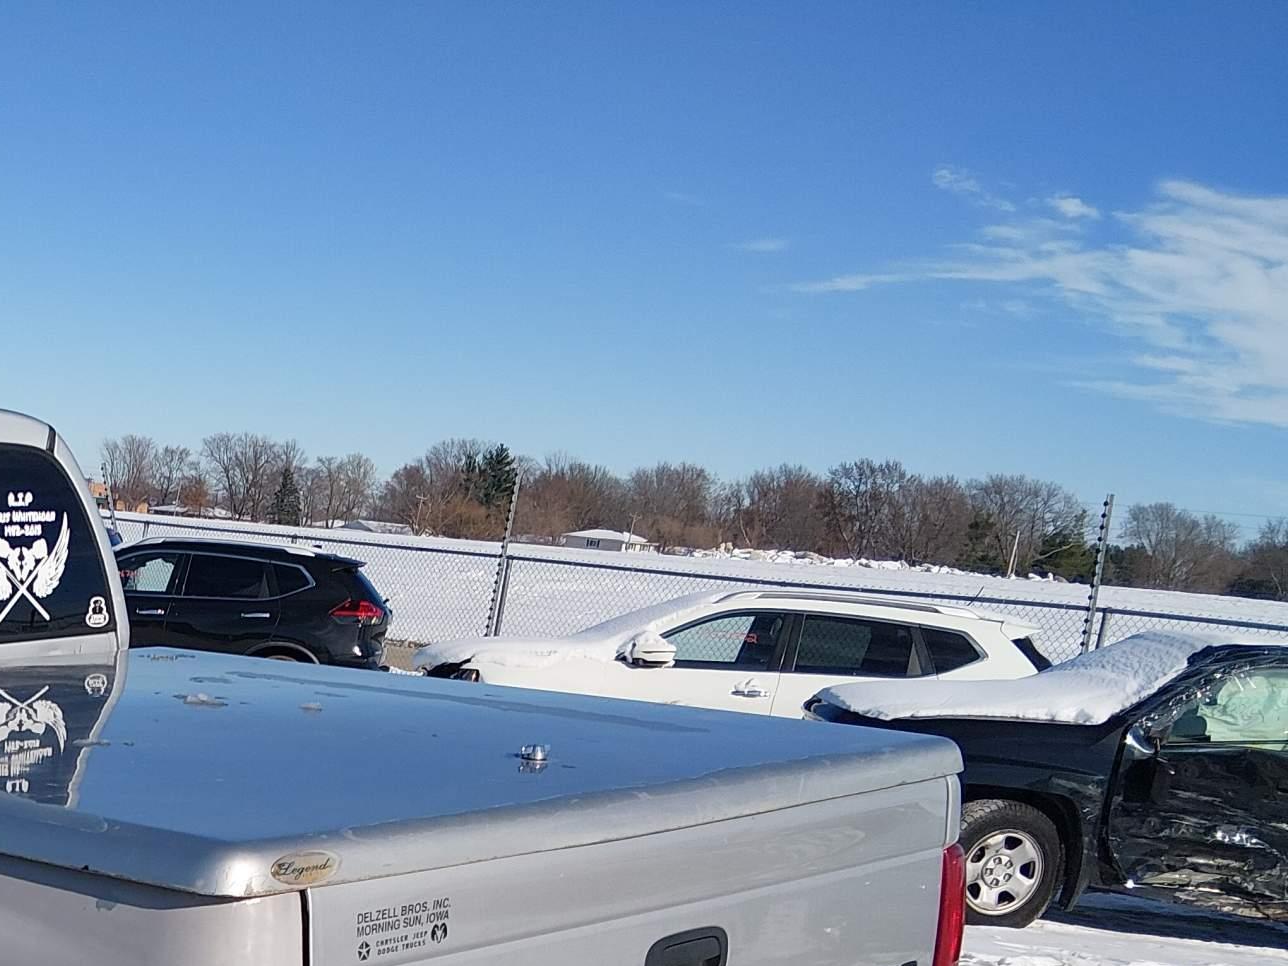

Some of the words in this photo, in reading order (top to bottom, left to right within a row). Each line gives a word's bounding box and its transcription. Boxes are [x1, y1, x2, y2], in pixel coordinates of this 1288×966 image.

[277, 857, 332, 881] Legend
[357, 907, 399, 925] DELZELL
[400, 901, 430, 917] BROS.
[432, 897, 451, 911] INC.
[356, 919, 401, 938] MORNING
[426, 909, 450, 924] IOWA
[375, 934, 409, 948] CHRYSLER
[412, 930, 428, 941] JEEP
[377, 945, 399, 956] DODGE
[402, 940, 426, 951] TRUCKS
